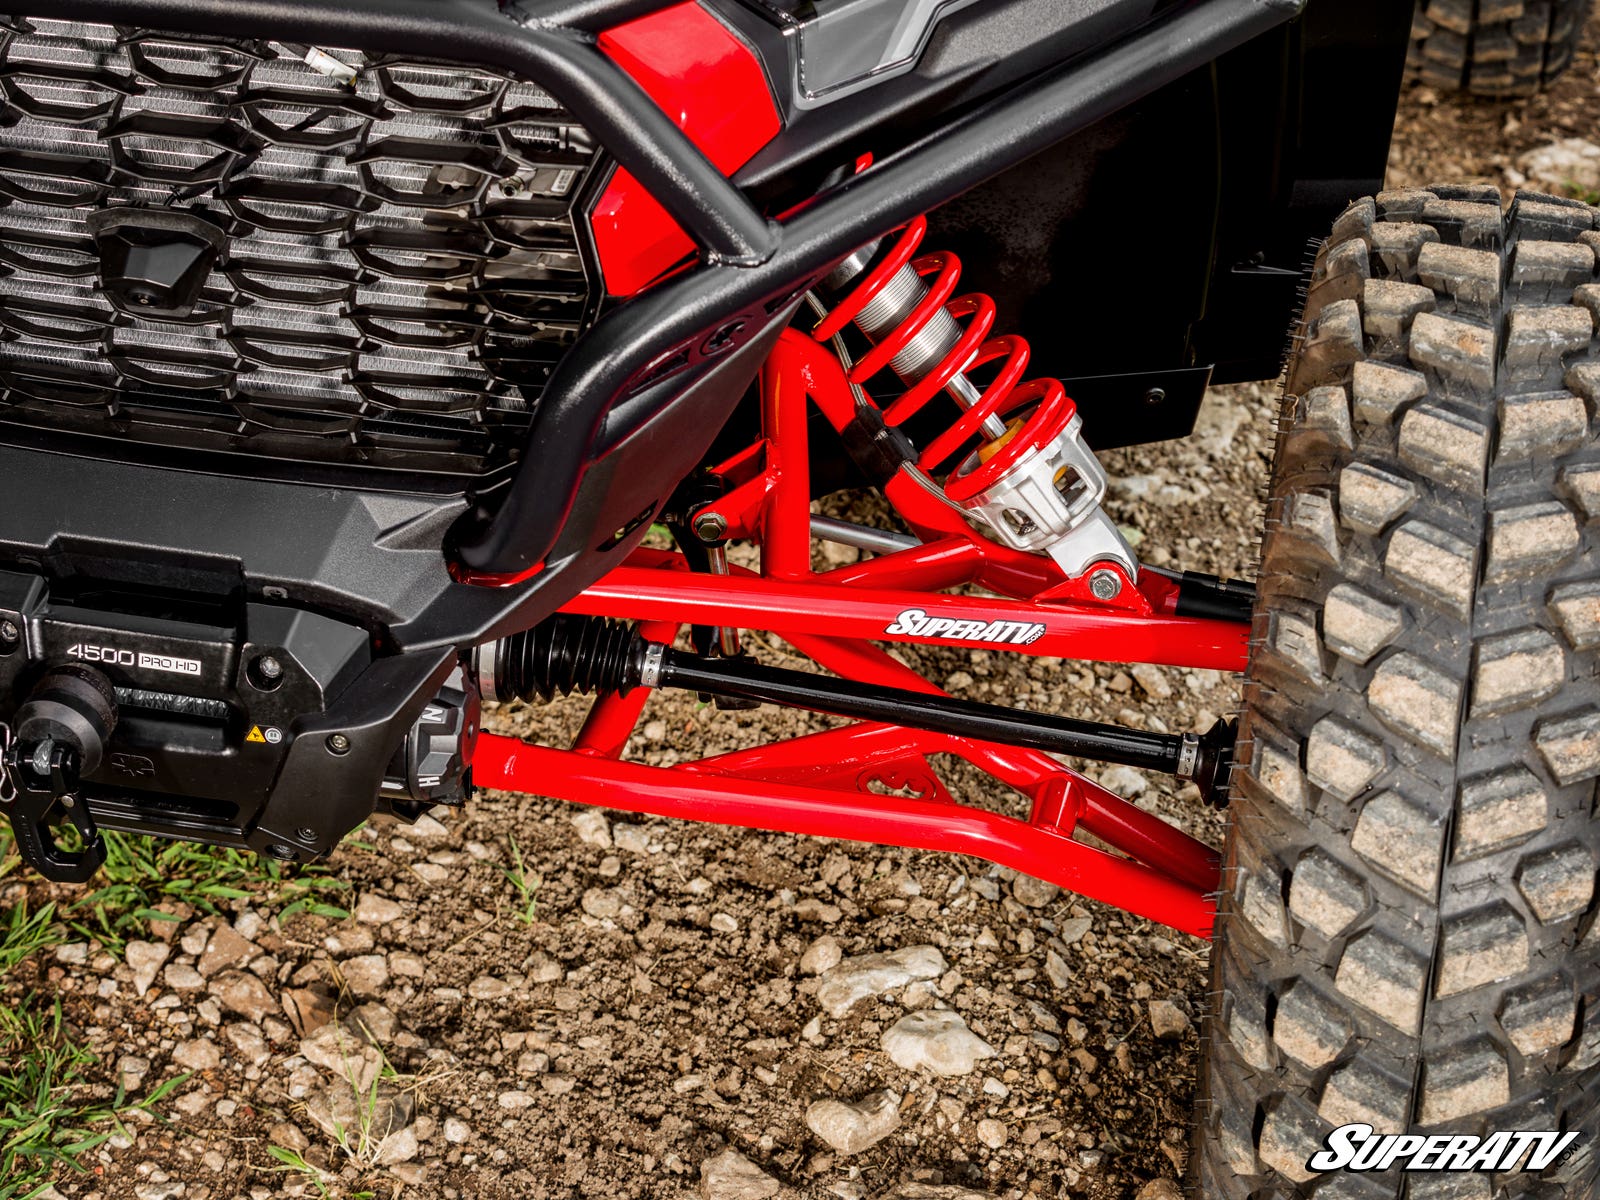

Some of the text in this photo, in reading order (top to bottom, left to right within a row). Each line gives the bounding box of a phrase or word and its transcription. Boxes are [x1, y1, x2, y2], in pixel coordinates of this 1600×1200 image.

[66, 643, 198, 672] 4500 PRO HD
